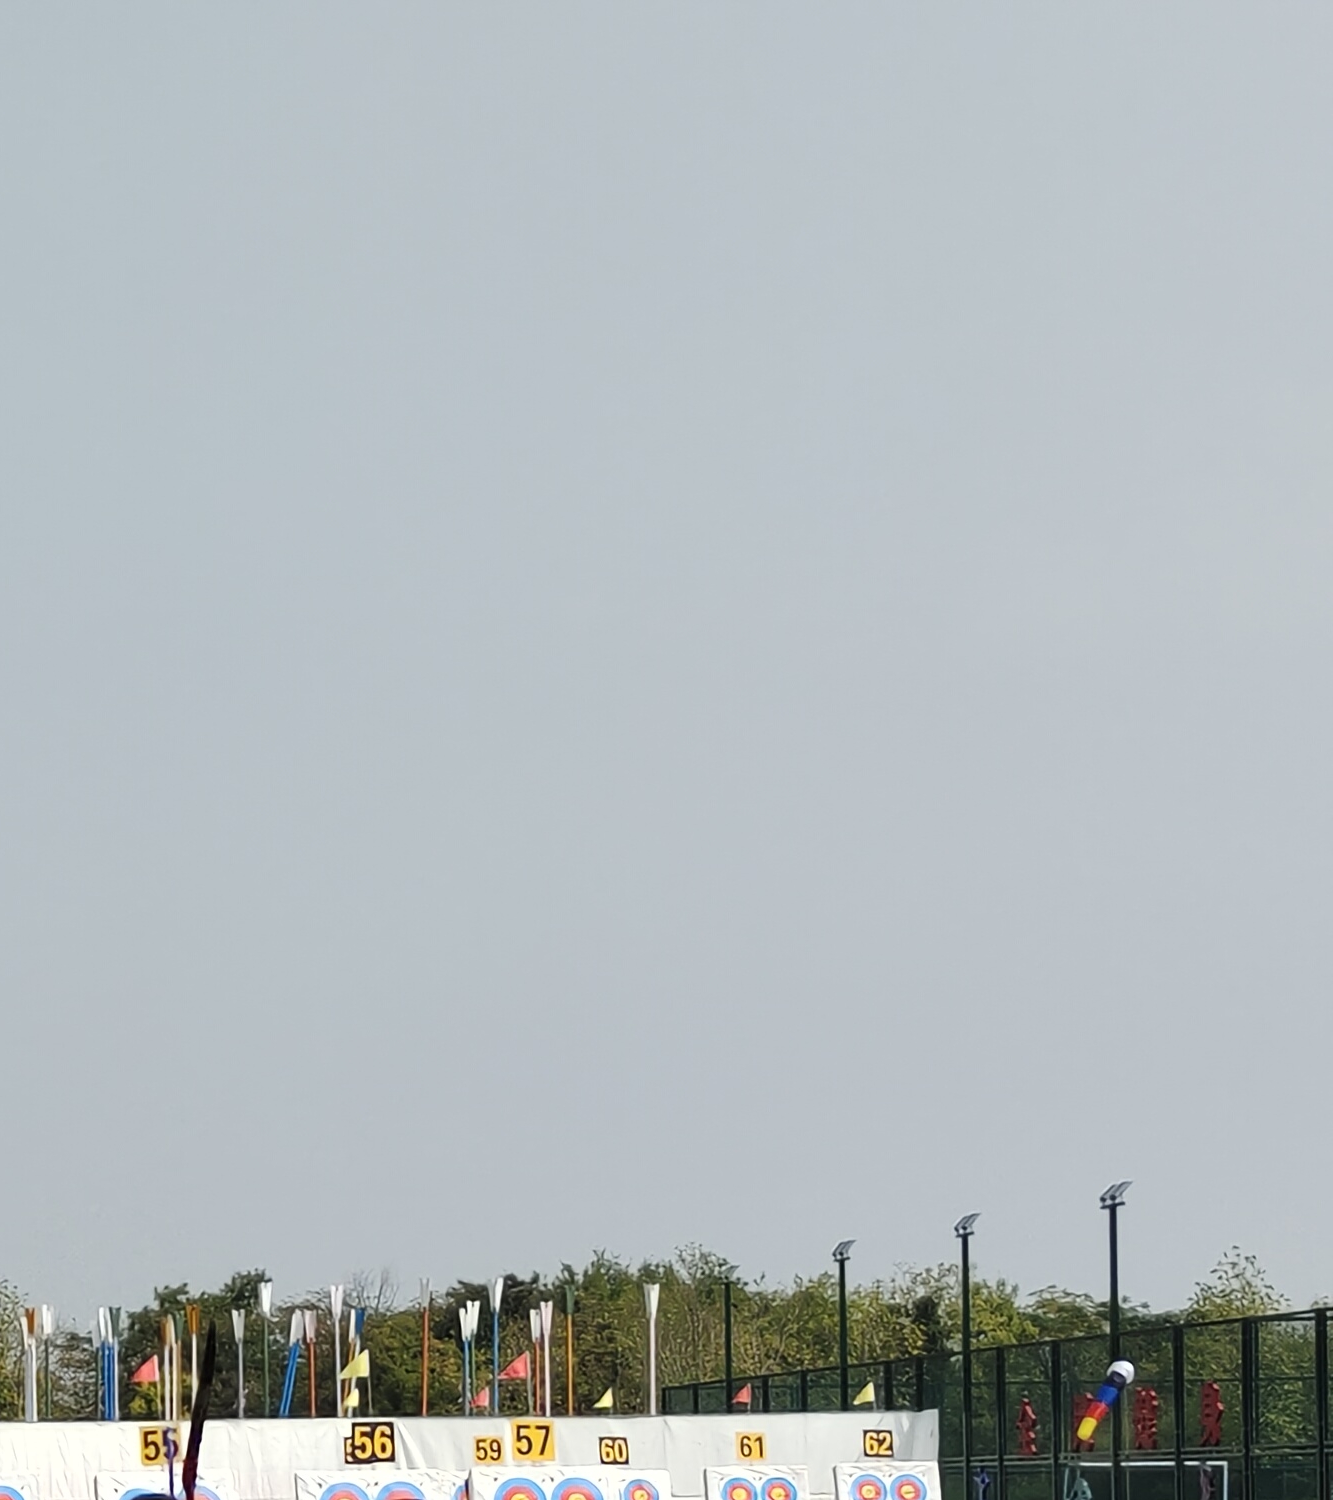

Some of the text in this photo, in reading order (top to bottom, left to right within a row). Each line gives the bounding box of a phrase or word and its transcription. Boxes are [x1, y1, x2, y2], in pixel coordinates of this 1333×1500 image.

[143, 1430, 178, 1461] 55
[355, 1425, 392, 1460] 56
[477, 1440, 500, 1460] 59
[516, 1424, 553, 1456] 57
[602, 1440, 625, 1462] 60
[740, 1435, 763, 1457] 61
[865, 1433, 891, 1454] 62
